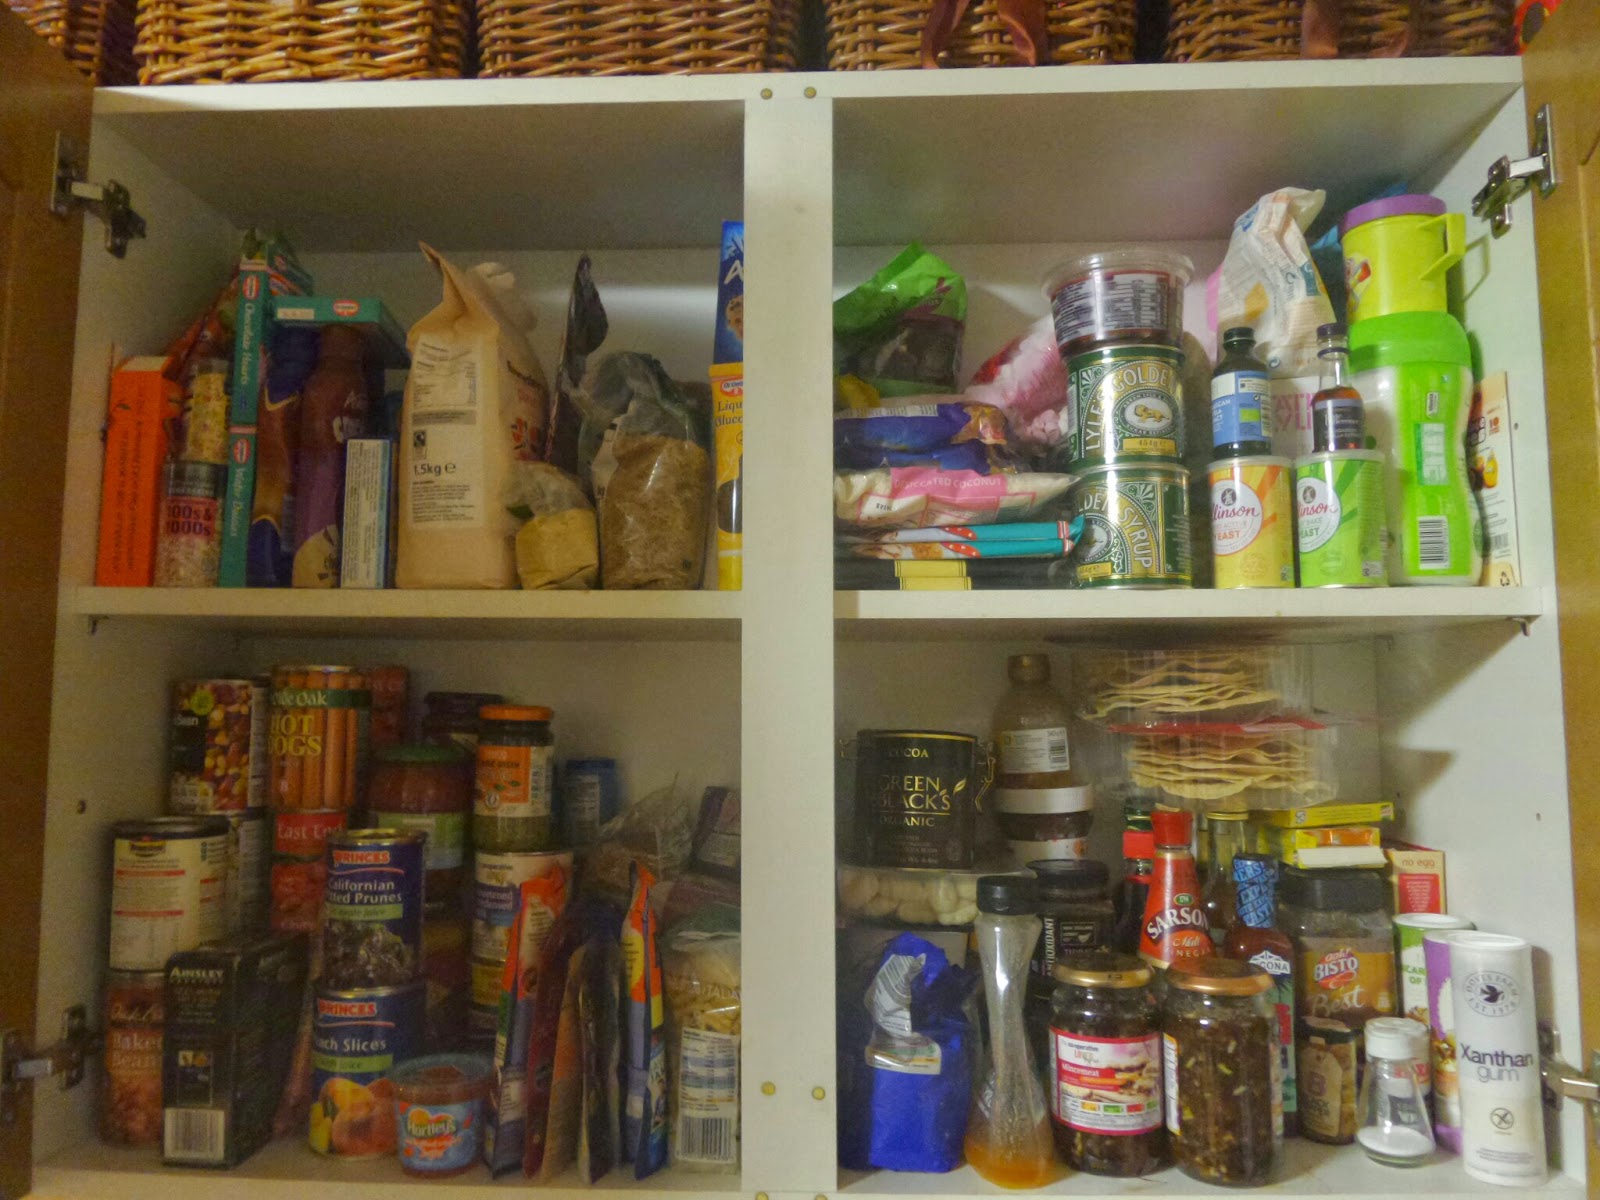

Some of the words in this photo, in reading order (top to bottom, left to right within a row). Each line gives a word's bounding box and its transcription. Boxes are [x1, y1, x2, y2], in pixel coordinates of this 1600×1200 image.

[1113, 366, 1177, 392] GOLDEN
[413, 464, 442, 477] 1.5kg
[953, 477, 1001, 489] COCONUT
[1121, 507, 1153, 568] SYRUP
[354, 892, 402, 905] Prunes
[1314, 956, 1359, 982] BISTO
[1311, 985, 1368, 1017] Best
[343, 1038, 387, 1052] Slices
[1460, 1043, 1534, 1068] Xanthan
[1062, 1061, 1100, 1078] Mincemeat
[1477, 1065, 1520, 1083] gum
